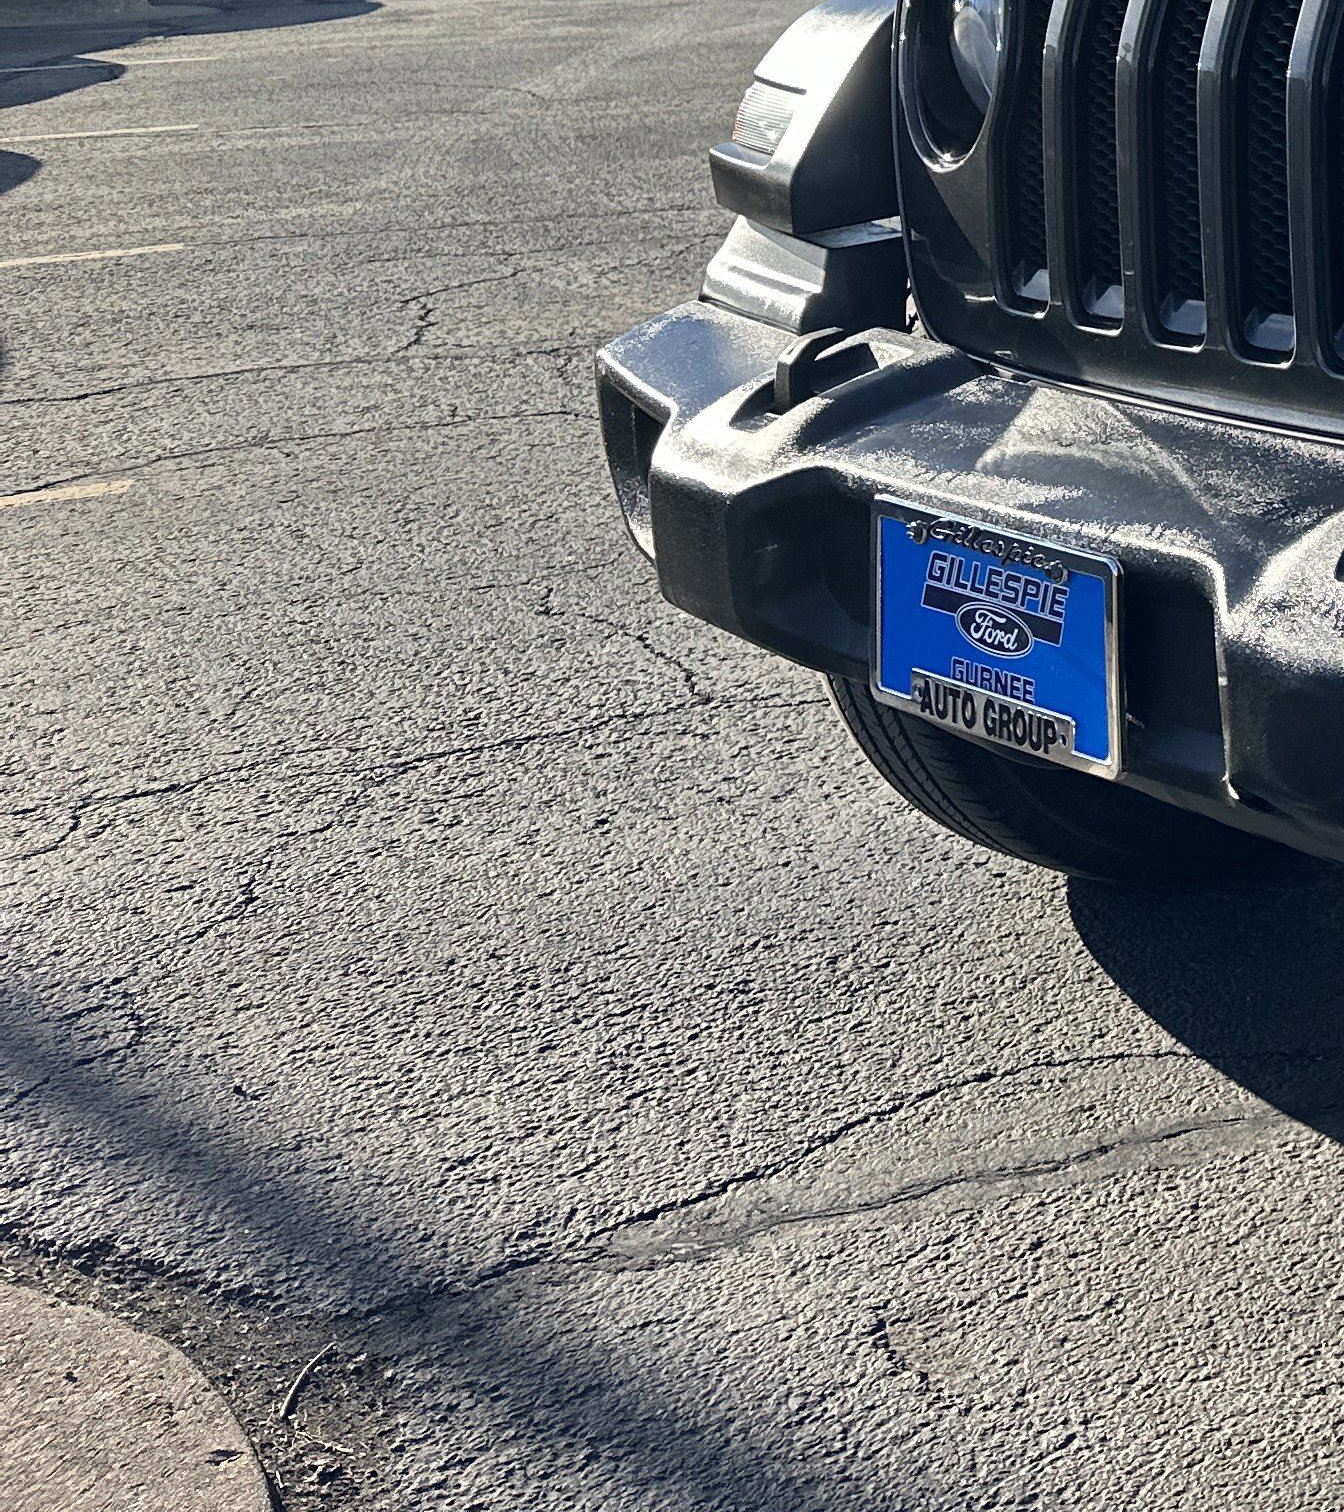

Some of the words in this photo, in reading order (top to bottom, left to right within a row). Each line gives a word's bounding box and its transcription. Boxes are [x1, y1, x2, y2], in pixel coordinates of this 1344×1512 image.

[926, 550, 1070, 620] GILLESPIE
[969, 609, 1019, 651] Ford
[951, 656, 1036, 704] GURNEE
[920, 678, 977, 729] AUTO
[983, 697, 1057, 755] GROUP
